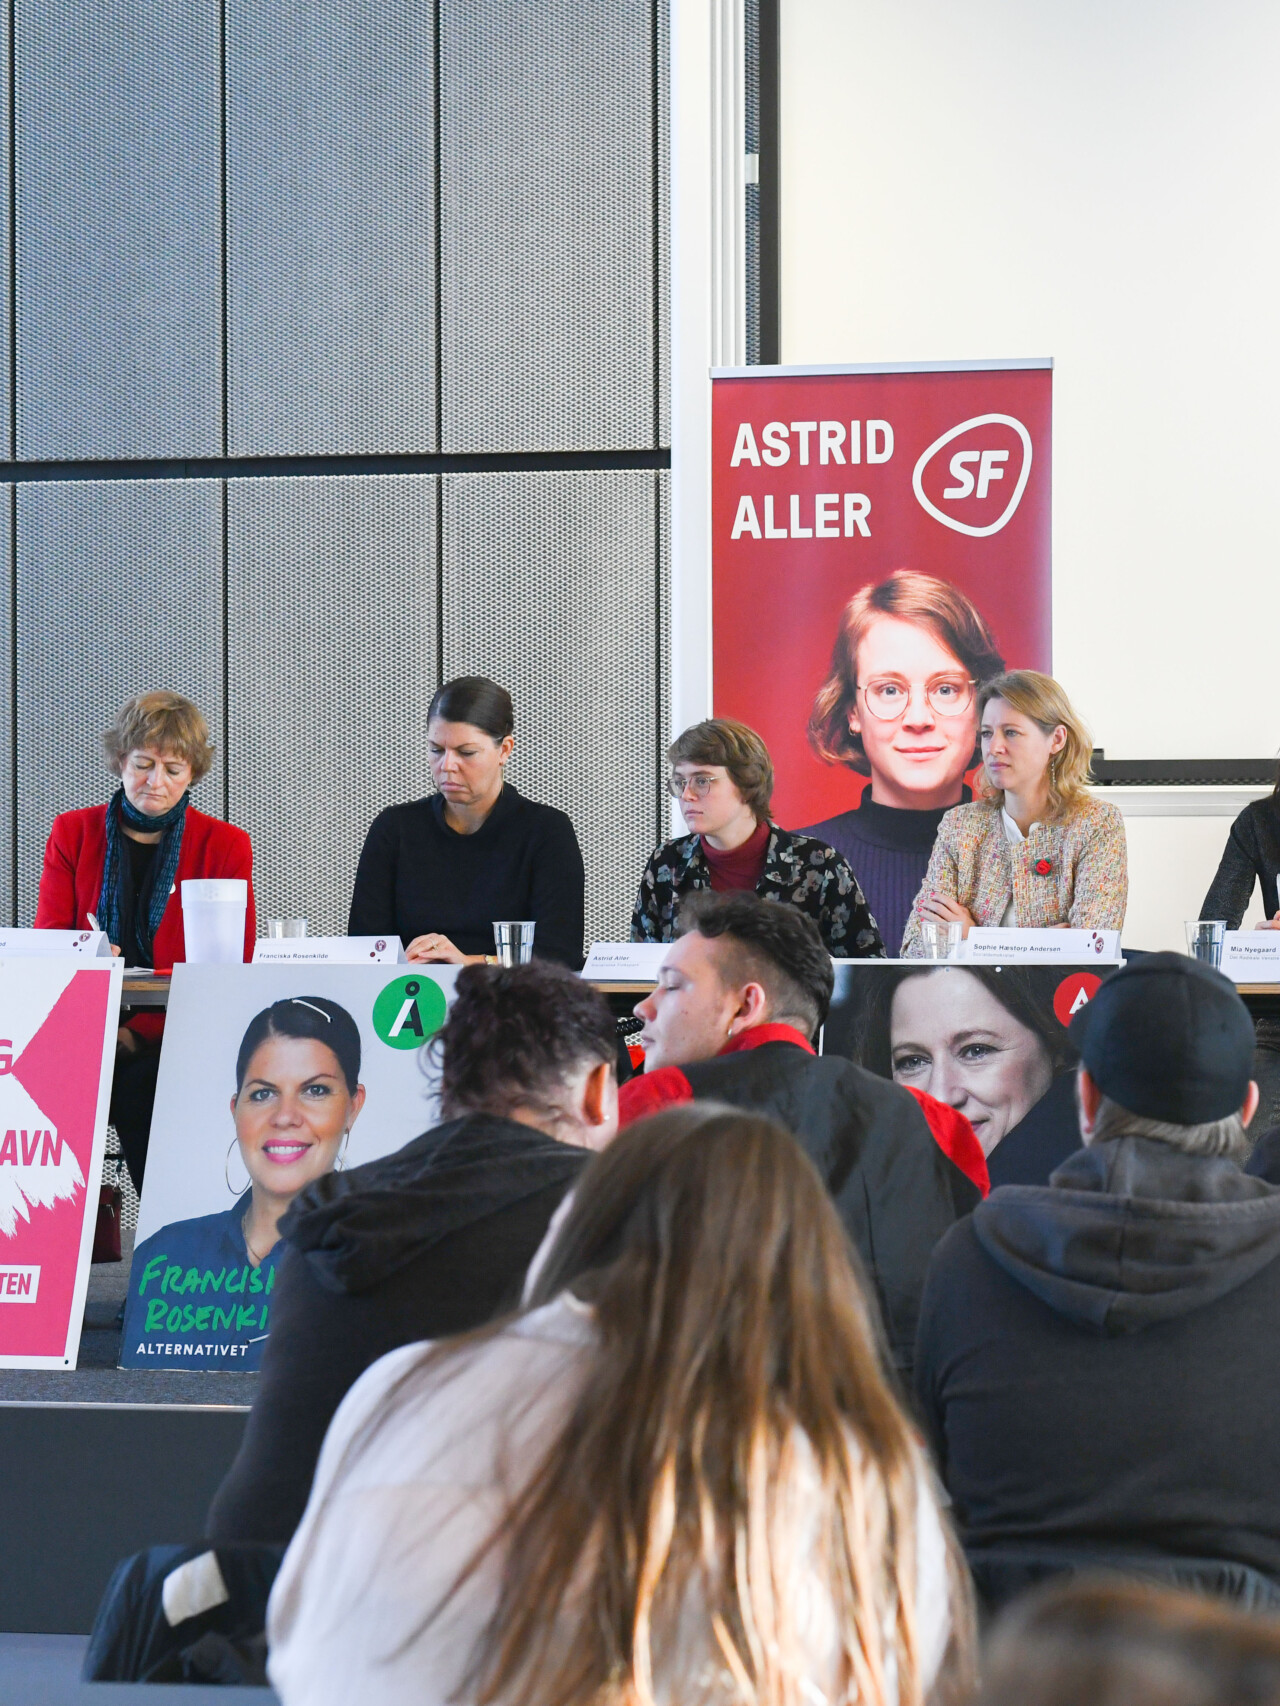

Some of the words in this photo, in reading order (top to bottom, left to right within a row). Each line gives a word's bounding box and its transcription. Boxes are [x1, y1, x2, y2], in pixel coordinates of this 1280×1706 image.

[730, 419, 894, 467] ASTRID
[943, 450, 1009, 499] SF
[730, 492, 872, 539] ALLER
[974, 943, 997, 951] Sophie
[999, 944, 1028, 953] Hæstorp
[1244, 946, 1277, 954] Nyegaard
[388, 981, 424, 1037] Å
[136, 1343, 249, 1356] ALTERNATIVET
